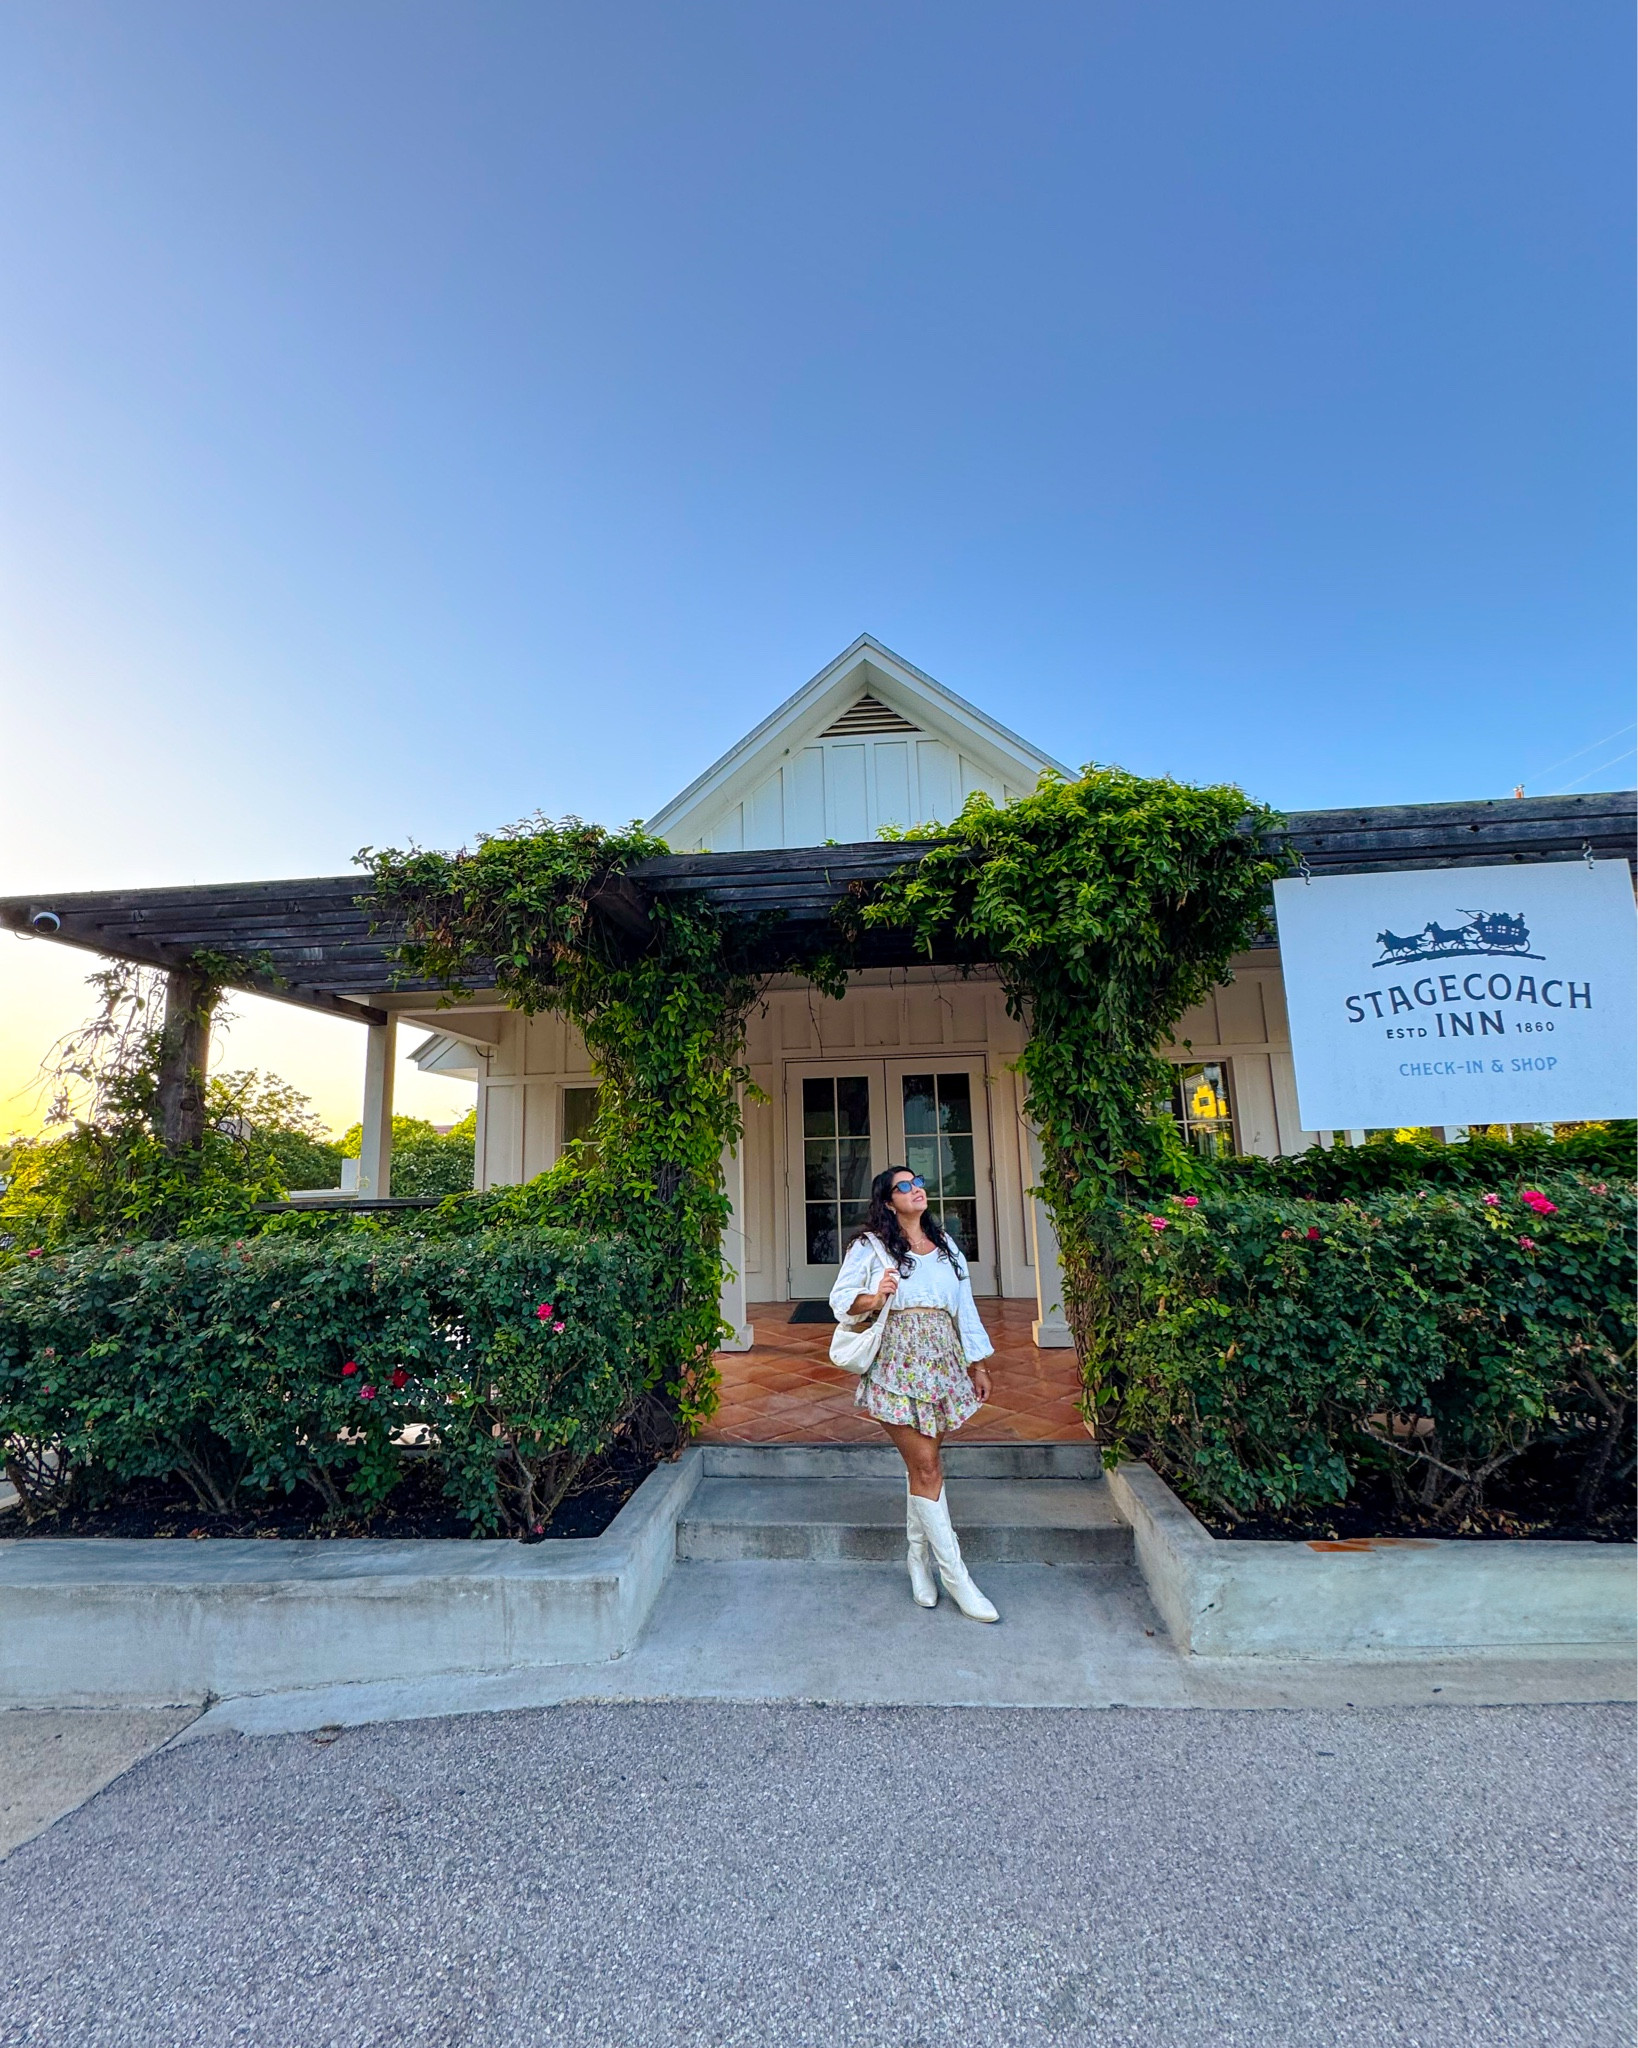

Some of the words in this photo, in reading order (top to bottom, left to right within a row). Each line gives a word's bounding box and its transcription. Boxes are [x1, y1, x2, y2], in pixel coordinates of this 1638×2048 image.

[1345, 973, 1592, 1023] STAGECOACH
[1386, 1027, 1428, 1039] ESTD
[1435, 1010, 1505, 1038] INN
[1516, 1021, 1555, 1033] 1860
[1399, 1059, 1484, 1077] CHECK-IN
[1491, 1059, 1504, 1073] &
[1511, 1056, 1558, 1072] SHOP
